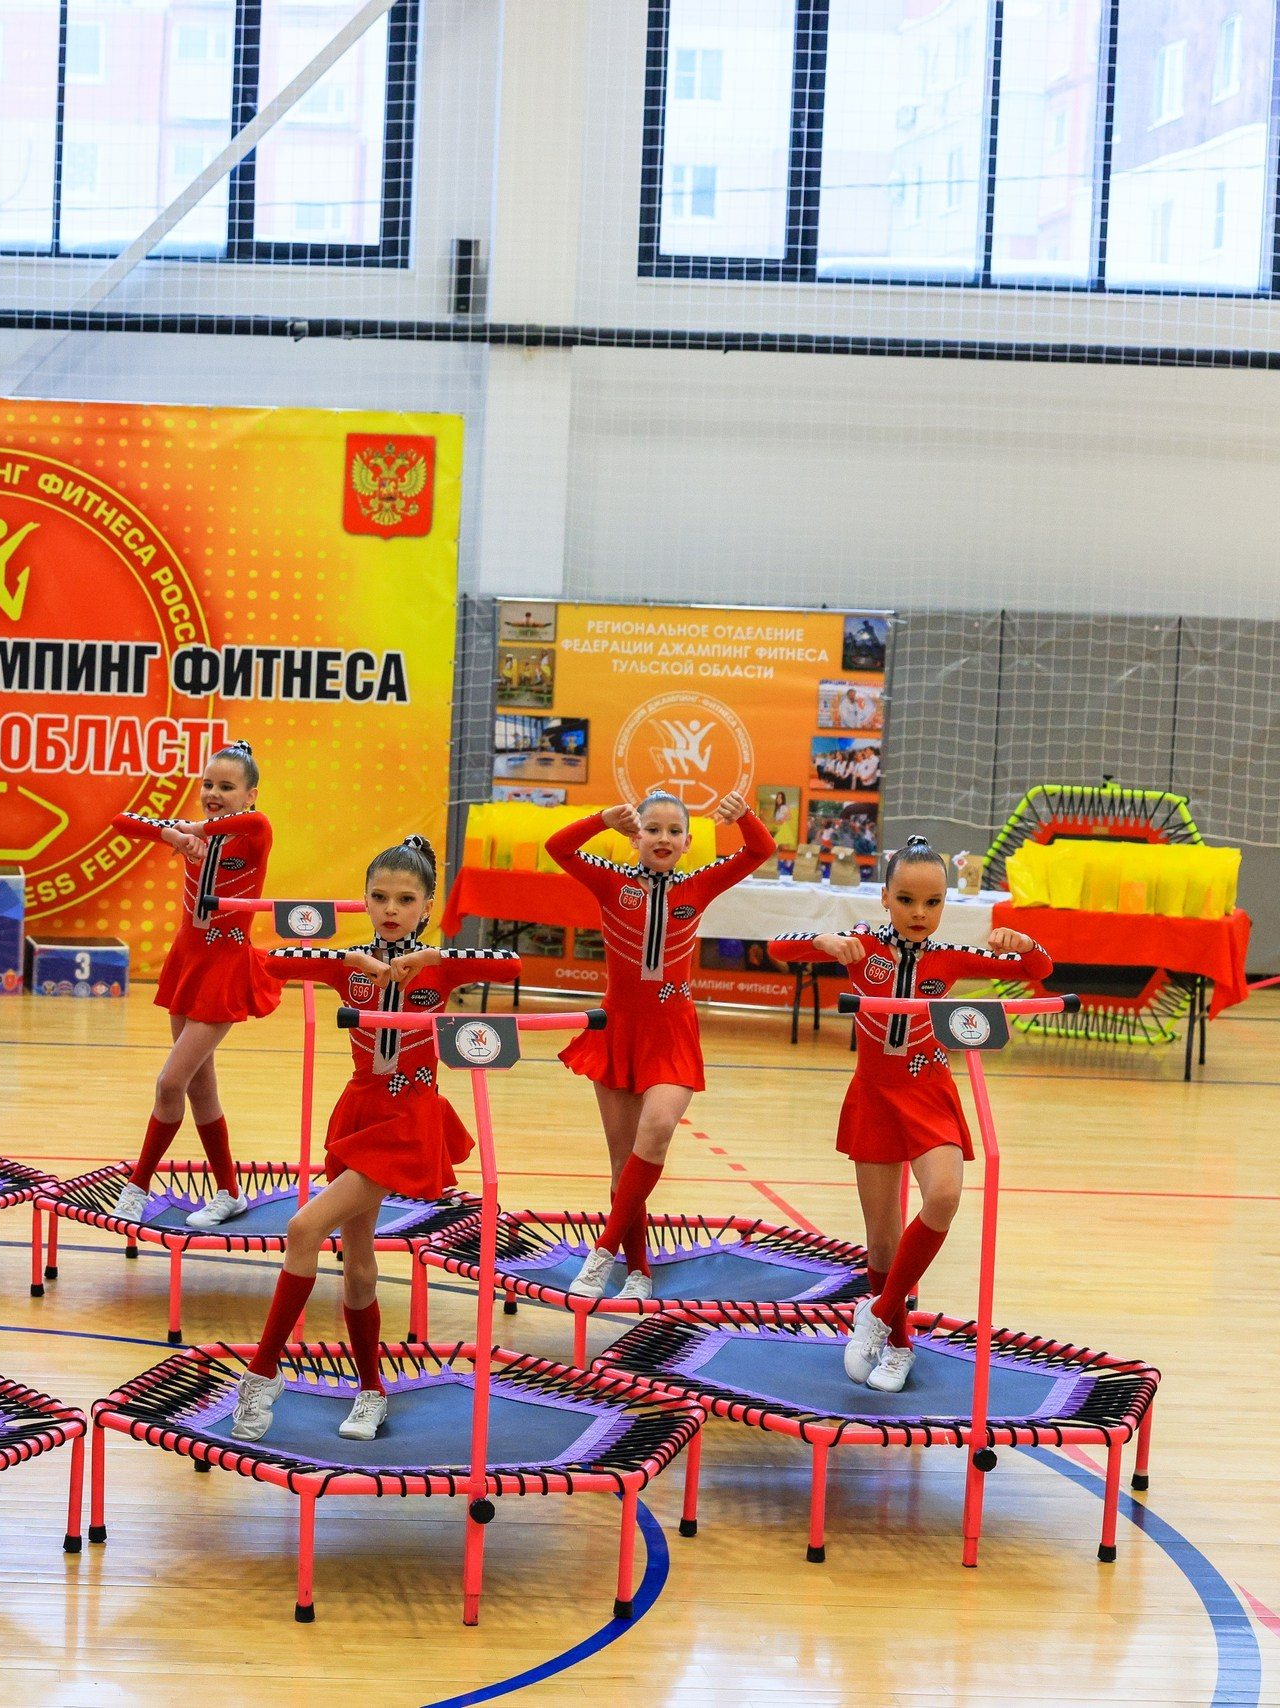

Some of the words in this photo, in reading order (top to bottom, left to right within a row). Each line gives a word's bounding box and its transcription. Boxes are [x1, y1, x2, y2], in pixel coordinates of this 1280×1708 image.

[37, 473, 157, 566] ФИТНЕСА
[151, 566, 198, 648] РОСС
[587, 620, 709, 639] РЕГИОНАЛЬНОЕ
[713, 625, 804, 642] ОТДЕЛЕНИЕ
[560, 638, 654, 655] ФЕДЕРАЦИИ
[658, 642, 752, 658] ДЖАМПИНГ
[755, 646, 829, 662] ФИТНЕСА
[172, 645, 409, 704] ФИТНЕСА
[612, 658, 694, 676] ТУЛЬСКОЙ
[699, 663, 775, 679] ОБЛАСТИ
[622, 895, 638, 906] 696
[74, 952, 91, 980] 3
[868, 965, 886, 980] 696
[352, 984, 369, 998] 696
[690, 979, 735, 991] АМПИНГ
